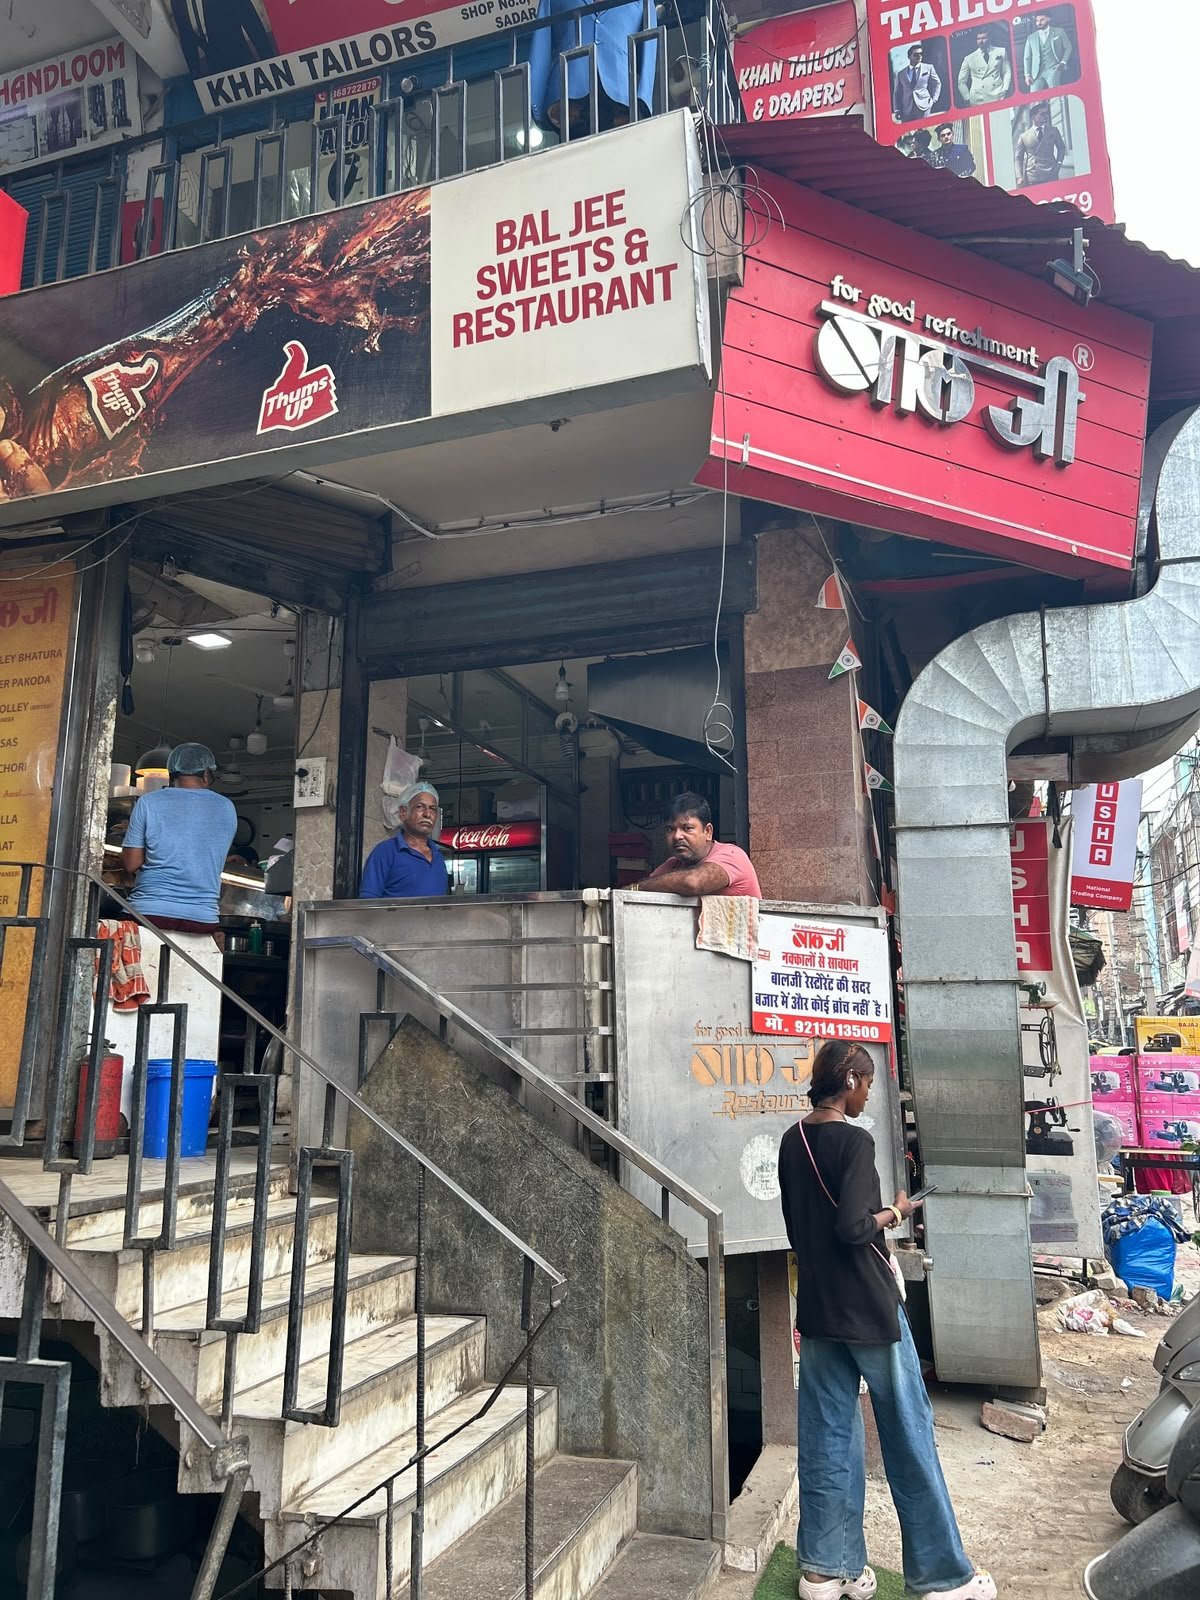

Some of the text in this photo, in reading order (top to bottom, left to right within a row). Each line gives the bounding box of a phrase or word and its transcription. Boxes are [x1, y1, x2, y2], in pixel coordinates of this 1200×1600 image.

[461, 1, 495, 20] SHOP
[495, 7, 537, 28] SADAR
[880, 0, 1045, 41] TAIL
[206, 20, 437, 108] KHAN TAILORS
[739, 41, 857, 91] KHAN TAILORS
[753, 79, 845, 120] & DRAPERS
[496, 189, 627, 255] BAL JEE
[476, 228, 649, 300] SWEETS &
[453, 263, 678, 348] RESTAURANT
[830, 274, 1040, 370] for good refreshment
[101, 372, 136, 417] Thums
[266, 376, 328, 416] Thums
[19, 649, 62, 662] BHATURA
[12, 675, 51, 687] PAKODA
[452, 823, 512, 849] Coca-Cola
[1094, 784, 1114, 862] USHA
[1072, 890, 1123, 902] Trading Company
[782, 952, 816, 968] नक्कालों
[818, 952, 826, 968] से
[827, 957, 859, 971] सावधान
[771, 971, 802, 988] बालजी
[836, 975, 849, 992] की
[851, 979, 871, 994] सदर
[755, 992, 778, 1007] बजार
[781, 991, 790, 1008] में
[791, 993, 809, 1010] और
[811, 994, 830, 1014] कोई
[852, 999, 871, 1016] नहीं
[795, 1020, 879, 1038] 9211413500
